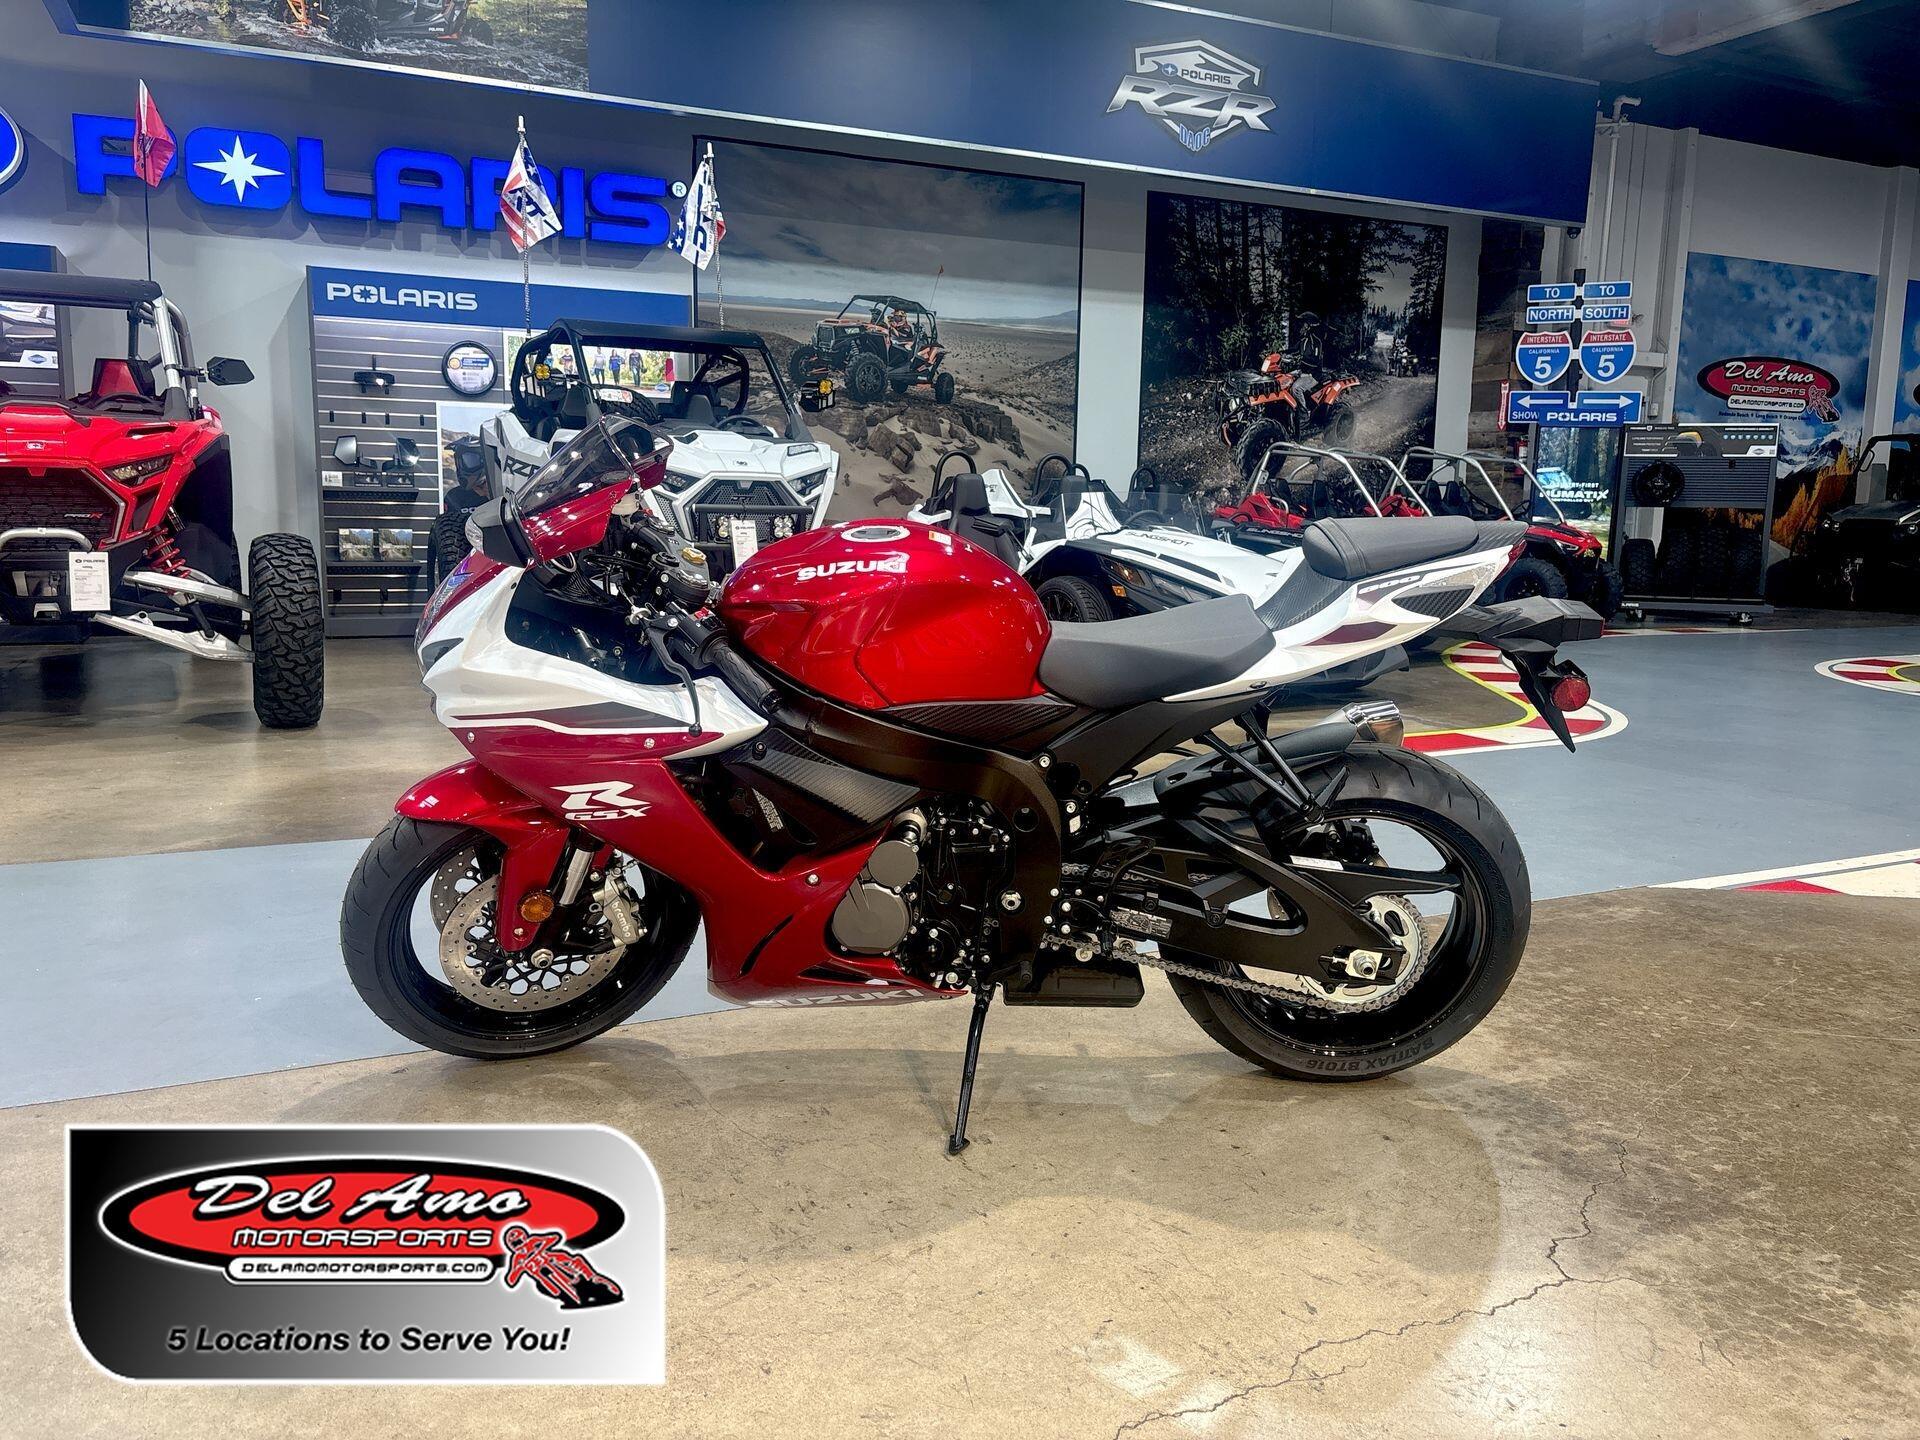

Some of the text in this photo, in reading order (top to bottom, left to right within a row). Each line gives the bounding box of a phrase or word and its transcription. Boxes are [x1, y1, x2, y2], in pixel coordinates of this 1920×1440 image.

[1181, 68, 1233, 85] POLARIS
[1106, 75, 1277, 131] RZR
[72, 112, 671, 247] POLARIS
[326, 282, 478, 311] POLARIS
[1544, 287, 1560, 298] TO
[1600, 285, 1615, 296] TO
[1529, 309, 1572, 321] NORTH
[1585, 307, 1627, 319] SOUTH
[1527, 335, 1563, 344] INTERSTATE
[1590, 333, 1627, 342] INTERSTATE
[1528, 347, 1560, 355] CALIFORNIA
[1534, 356, 1552, 379] 5
[1597, 354, 1615, 378] 5
[1725, 361, 1815, 383] Del Amo
[1731, 383, 1806, 396] MOTORSPORTS
[1512, 411, 1539, 420] SHOW
[1546, 412, 1617, 421] POLARIS
[1125, 531, 1194, 547] SLINGSHOT
[797, 559, 908, 581] SUZUKI
[564, 806, 652, 821] GSX
[611, 901, 632, 938] brembo
[748, 989, 924, 1007] SUZUKI
[1305, 1059, 1360, 1071] BT016
